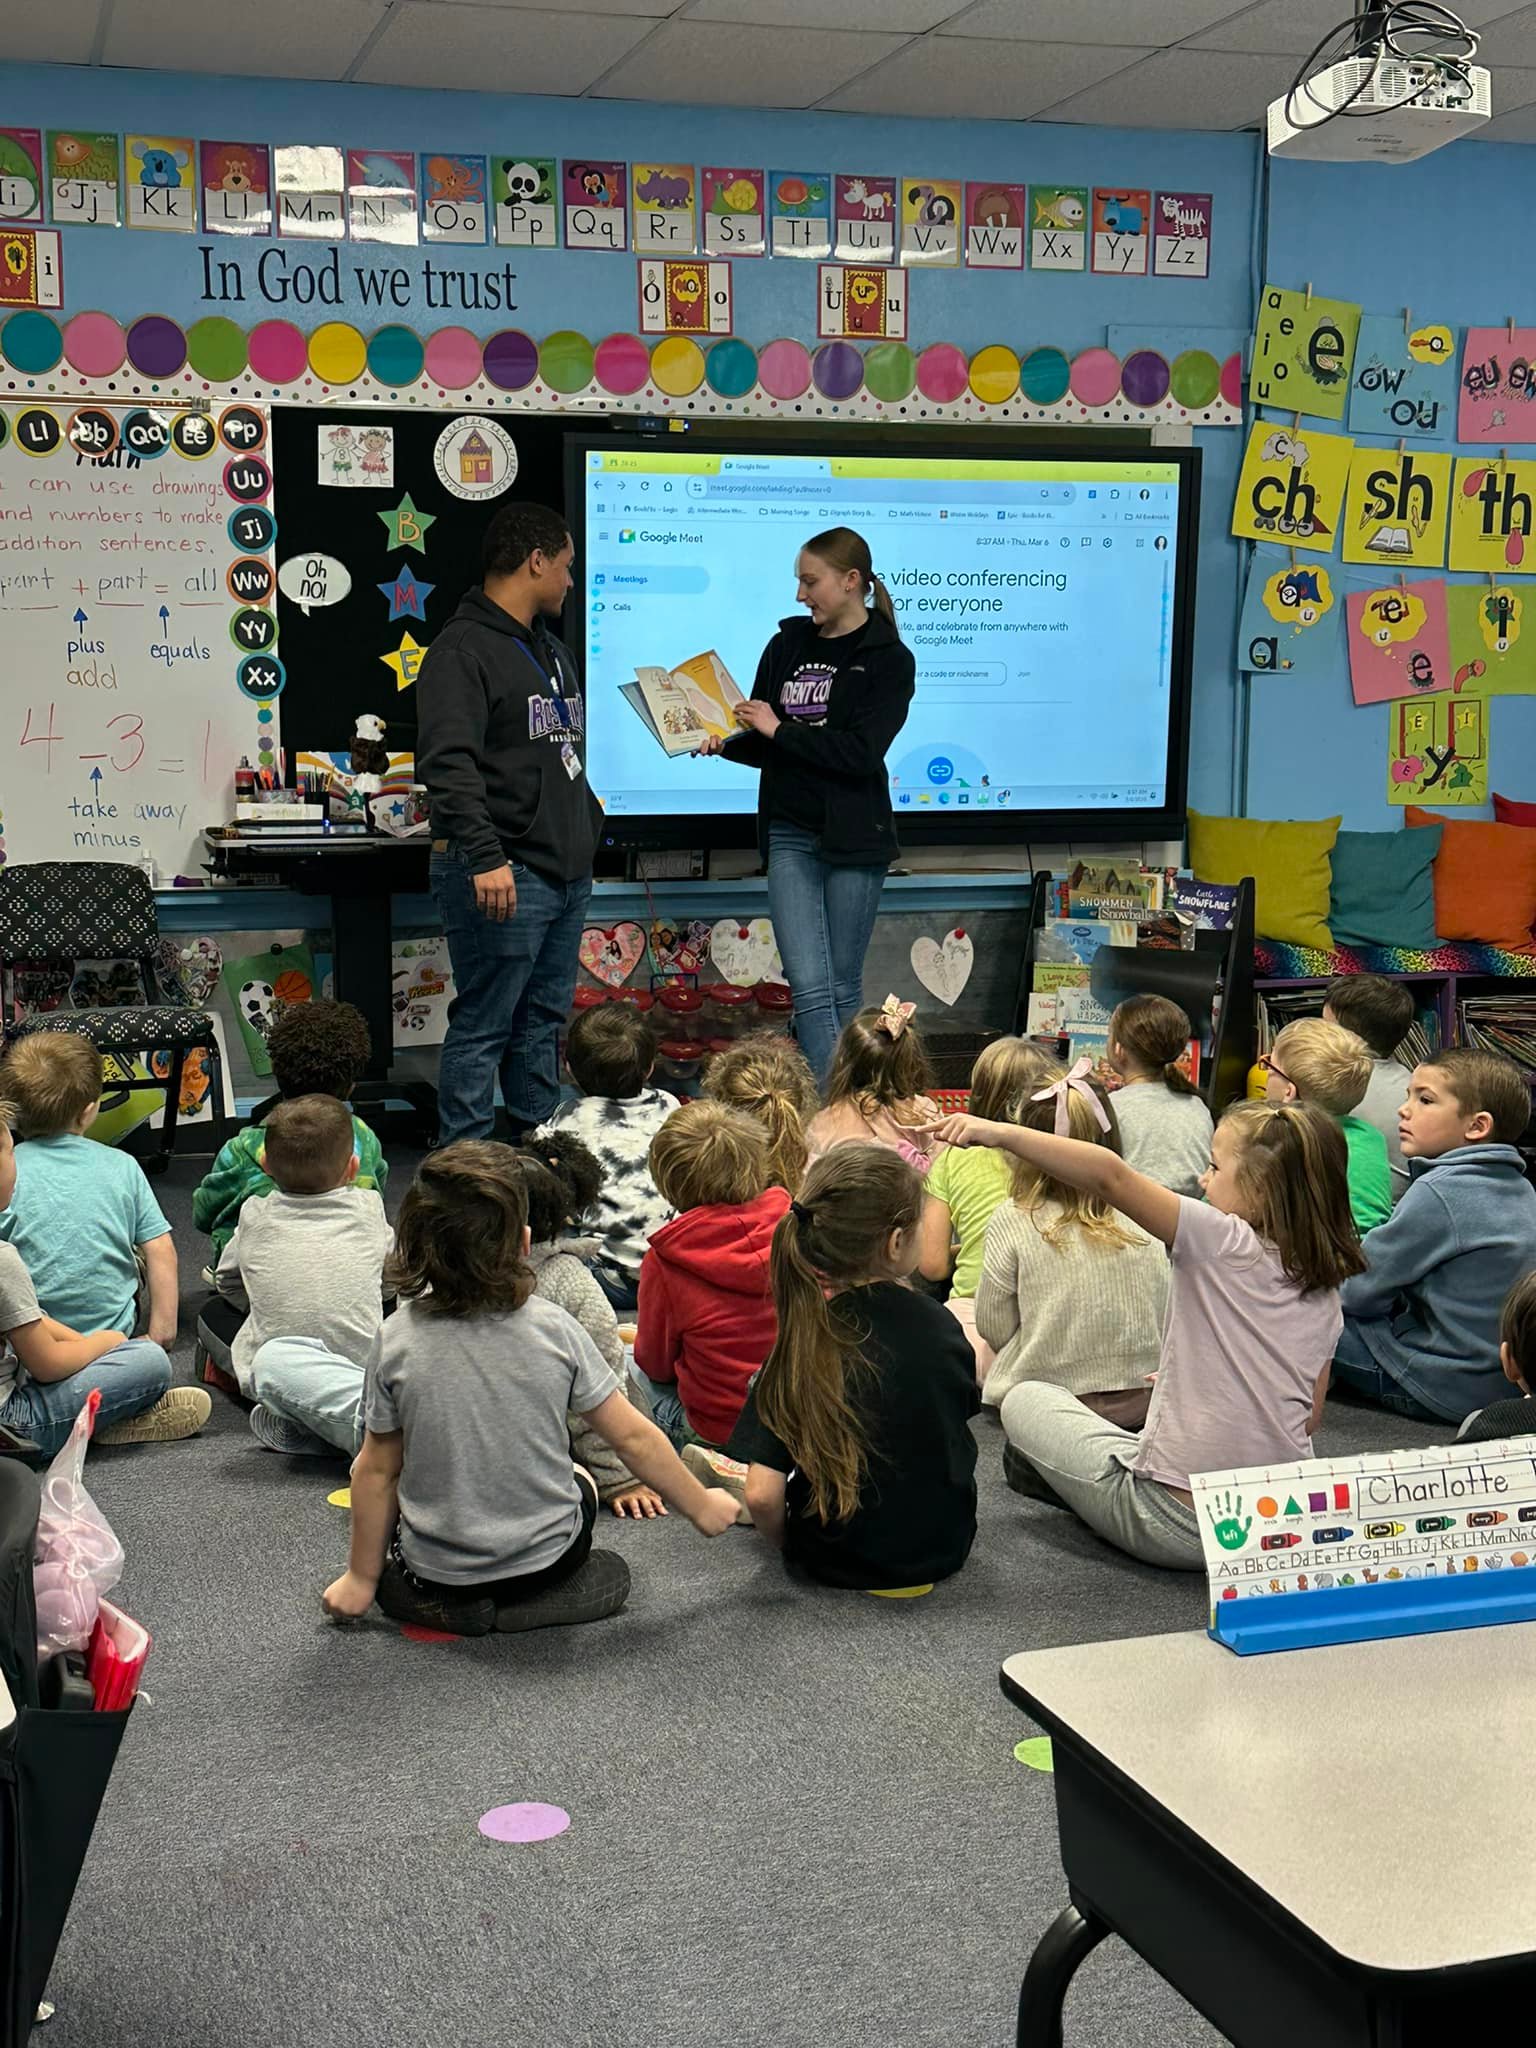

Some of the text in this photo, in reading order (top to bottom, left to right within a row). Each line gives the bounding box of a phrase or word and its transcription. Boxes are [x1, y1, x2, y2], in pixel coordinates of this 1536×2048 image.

[71, 183, 98, 223] Jj
[142, 187, 179, 217] Kk
[284, 197, 335, 222] Mm
[434, 204, 476, 231] Oo
[511, 207, 543, 245] Pp
[573, 209, 618, 247] Qq
[650, 214, 679, 240] Rr
[720, 217, 746, 242] Ss
[787, 220, 811, 245] Tt
[849, 223, 880, 248] Uu
[914, 227, 947, 251] Vv
[972, 229, 1017, 255] Ww
[1042, 233, 1073, 258] Xx
[1105, 235, 1134, 272] Yy
[1166, 239, 1195, 264] Zz
[44, 255, 54, 276] i
[198, 246, 519, 311] In God we trust
[643, 281, 661, 303] O
[714, 291, 727, 304] o
[825, 290, 842, 310] U
[1268, 291, 1282, 310] a
[888, 299, 901, 312] u
[1280, 317, 1294, 336] e
[1263, 332, 1271, 356] i
[1308, 325, 1345, 378] e
[1274, 362, 1288, 380] o
[1359, 367, 1406, 395] ow
[1257, 380, 1270, 399] u
[129, 424, 170, 446] Qq
[29, 472, 225, 506] can use drawings
[232, 470, 264, 490] Uu
[1364, 455, 1433, 522] sh
[1252, 466, 1316, 523] ch
[1479, 472, 1532, 536] th
[49, 507, 143, 525] numbers
[152, 507, 173, 523] to
[181, 508, 224, 524] make
[397, 510, 421, 543] B
[241, 518, 264, 540] Jj
[639, 530, 678, 545] Google
[0, 533, 215, 554] addition sentences.
[305, 559, 327, 579] Oh
[613, 575, 648, 585] Meetings
[891, 568, 942, 586] video
[946, 568, 1068, 591] conferencing
[98, 567, 149, 600] part
[184, 567, 217, 592] all
[232, 572, 269, 592] Ww
[394, 583, 417, 613] M
[917, 596, 1003, 616] everyone
[240, 620, 267, 643] Yy
[916, 621, 934, 632] and
[935, 621, 978, 632] celebrate
[980, 621, 1002, 632] from
[1003, 621, 1048, 633] anywhere
[1049, 621, 1069, 632] with
[67, 636, 211, 667] plus equals
[914, 635, 973, 647] Google Meet
[399, 648, 420, 680] E
[1249, 637, 1278, 670] a
[66, 659, 118, 690] add
[247, 666, 277, 687] Xx
[20, 702, 64, 774] 4
[106, 713, 145, 772] 3
[67, 796, 188, 831] take away
[74, 823, 142, 848] minus
[1079, 896, 1133, 908] SNOWMEN
[1178, 894, 1230, 912] SNOWFLAKE
[1101, 908, 1154, 920] Snowballs
[1369, 1464, 1509, 1505] Charlotte
[1218, 1562, 1239, 1577] Aa
[1245, 1558, 1263, 1574] Bb
[1266, 1555, 1285, 1571] Cc
[1291, 1552, 1310, 1567] Dd
[1315, 1549, 1331, 1564] Ee
[1337, 1545, 1355, 1561] Ff
[1358, 1544, 1379, 1564] Gg
[1384, 1540, 1404, 1557] Hh
[1421, 1536, 1437, 1558] Jj
[1441, 1535, 1458, 1550] Kk
[1480, 1529, 1506, 1545] Mm
[1509, 1527, 1528, 1543] Nn
